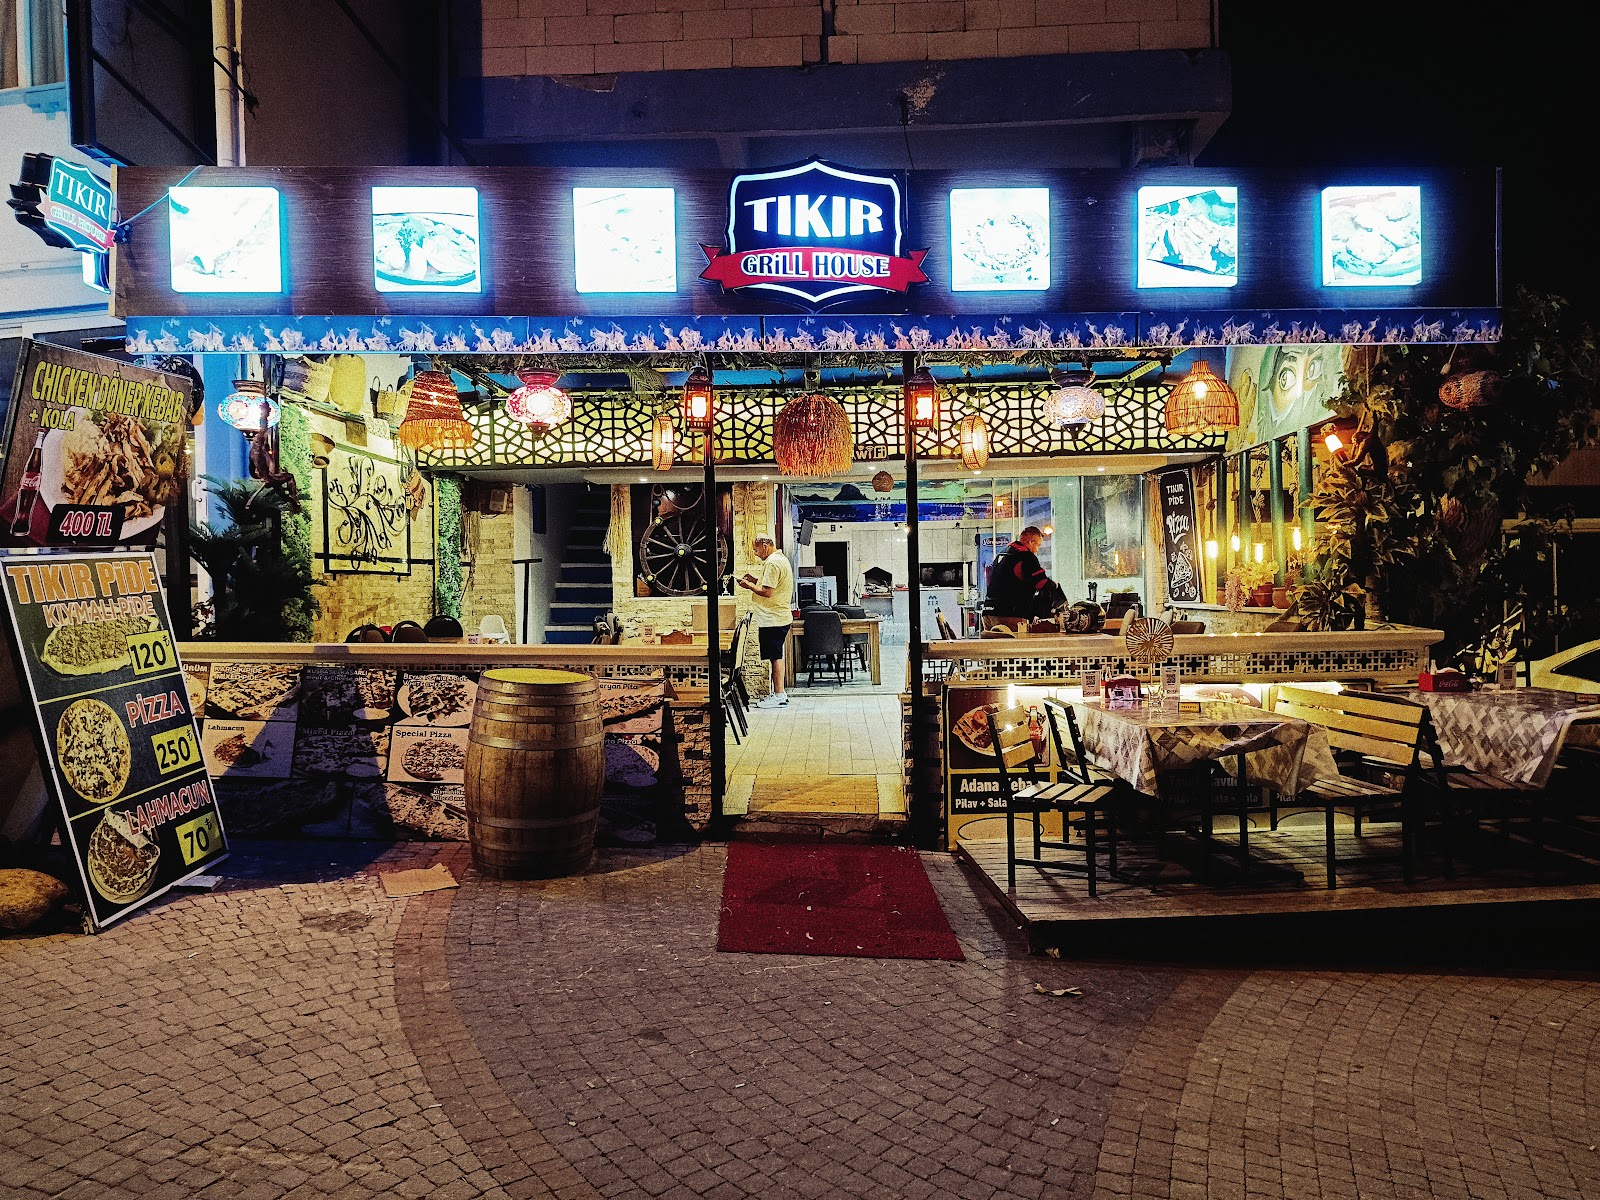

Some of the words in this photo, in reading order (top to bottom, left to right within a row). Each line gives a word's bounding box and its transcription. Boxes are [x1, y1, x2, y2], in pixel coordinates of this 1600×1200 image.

[56, 169, 107, 220] TIKIR
[744, 194, 884, 238] TIKIR
[812, 251, 891, 278] HOUSE
[31, 361, 99, 409] CHICKEN
[95, 371, 143, 417] DÖNER
[141, 385, 185, 423] KEBAB
[40, 407, 76, 431] KOLA
[59, 511, 94, 536] 400
[97, 511, 113, 536] TL
[6, 563, 97, 605] TIKIR
[42, 599, 119, 628] KIYMALI
[182, 663, 208, 672] ÜRÜM
[395, 729, 427, 738] Special
[429, 731, 452, 739] Pizza
[959, 777, 1000, 794] Adana
[124, 779, 211, 837] LAHMACUN
[955, 798, 978, 809] Pilav
[987, 798, 1008, 809] Sala
